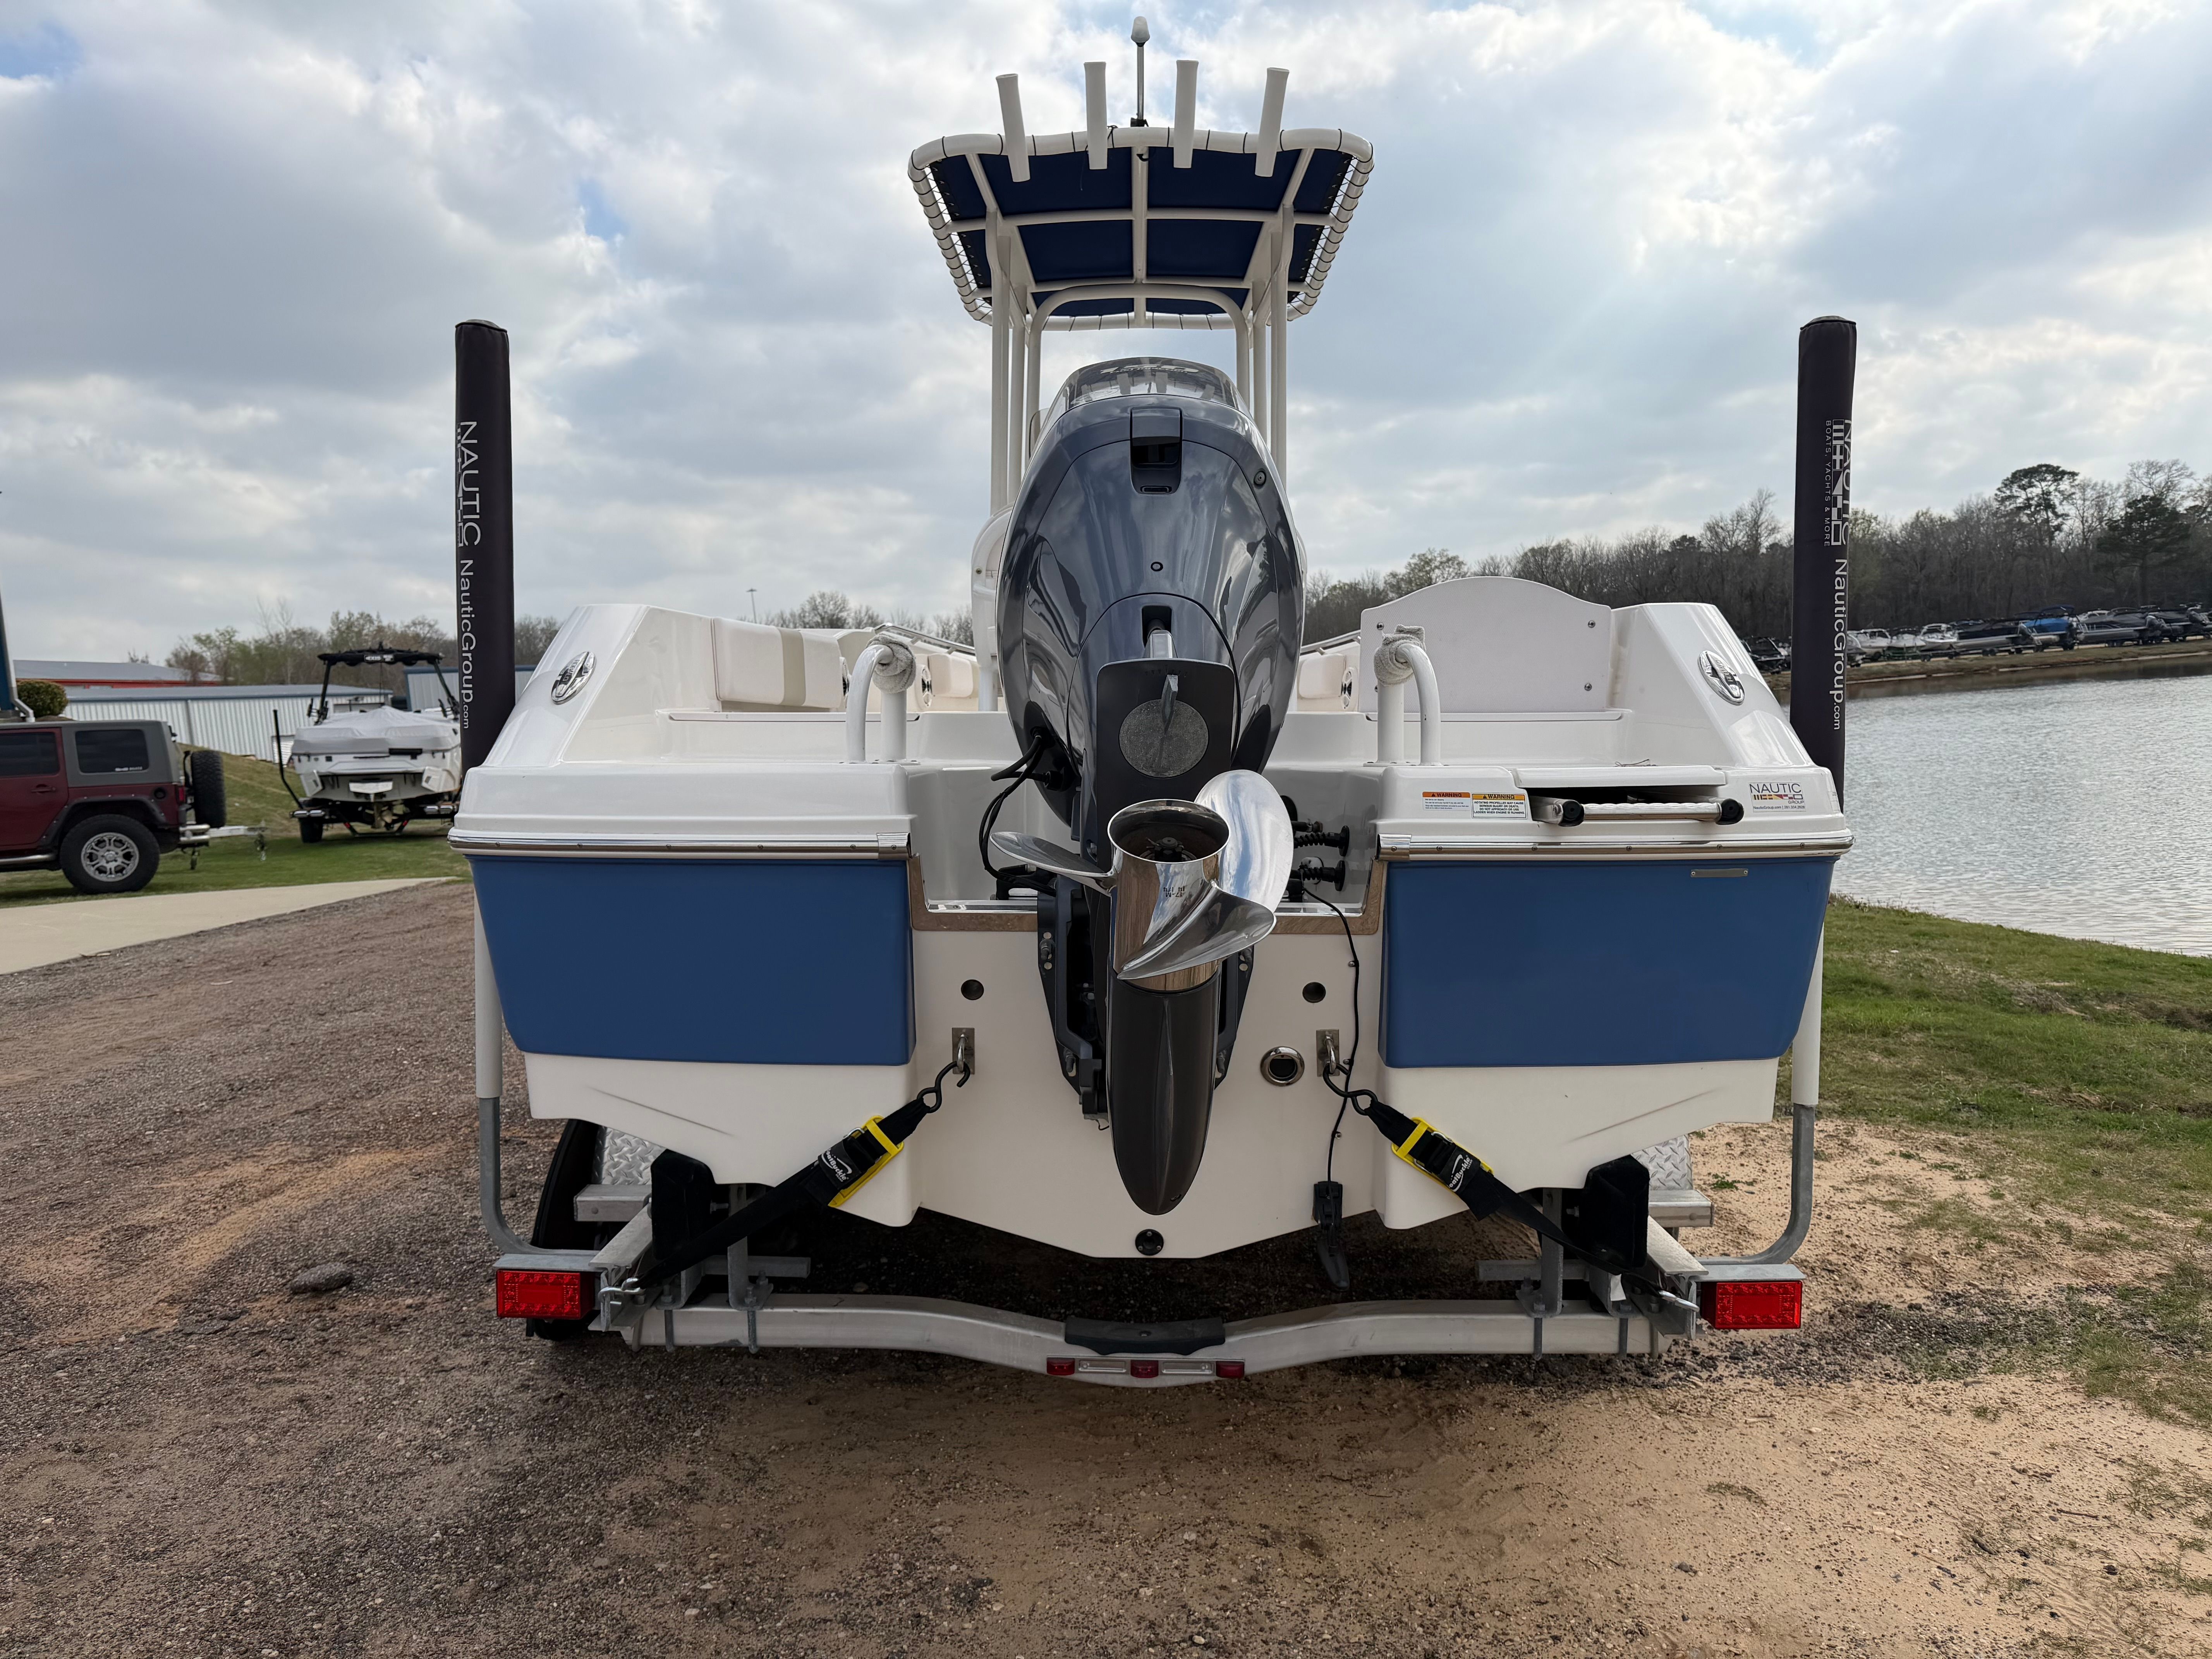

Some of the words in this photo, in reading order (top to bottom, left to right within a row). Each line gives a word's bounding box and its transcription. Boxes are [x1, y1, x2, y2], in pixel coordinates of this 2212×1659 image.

[1100, 364, 1199, 374] 150
[460, 421, 481, 546] NAUTIC
[460, 560, 476, 729] NauticGroup.com
[1829, 559, 1847, 730] NauticGroup.com
[1749, 783, 1801, 793] NAUTIC
[1447, 1157, 1470, 1188] oatBuckle
